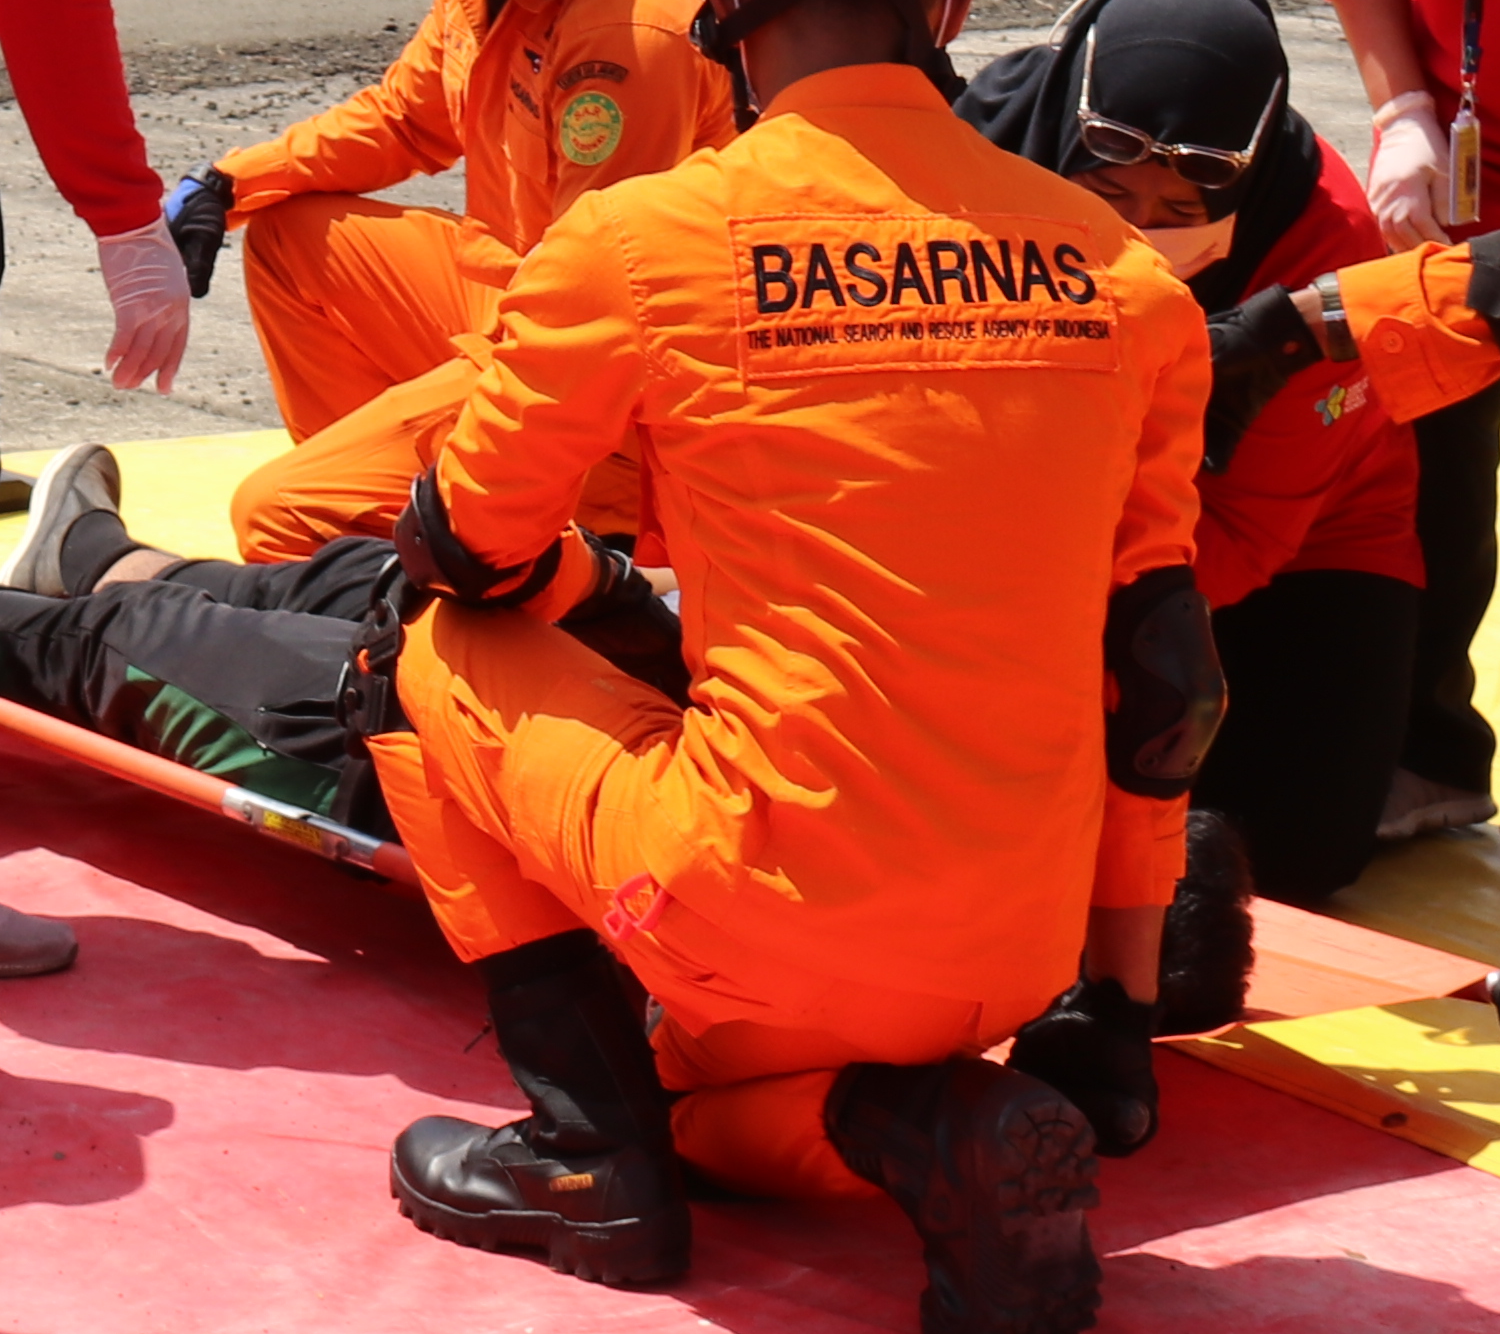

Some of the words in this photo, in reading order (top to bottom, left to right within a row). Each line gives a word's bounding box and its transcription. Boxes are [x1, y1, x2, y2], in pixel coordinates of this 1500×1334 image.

[750, 239, 1099, 314] BASARNAS
[748, 329, 772, 349] THE
[776, 325, 838, 348] NATIONAL
[844, 322, 894, 343] SEARCH
[901, 322, 924, 341] AND
[929, 321, 977, 340] RESCUE
[983, 319, 1031, 339] AGENCY
[1035, 319, 1050, 338] OF
[1054, 319, 1111, 339] INDONESIA
